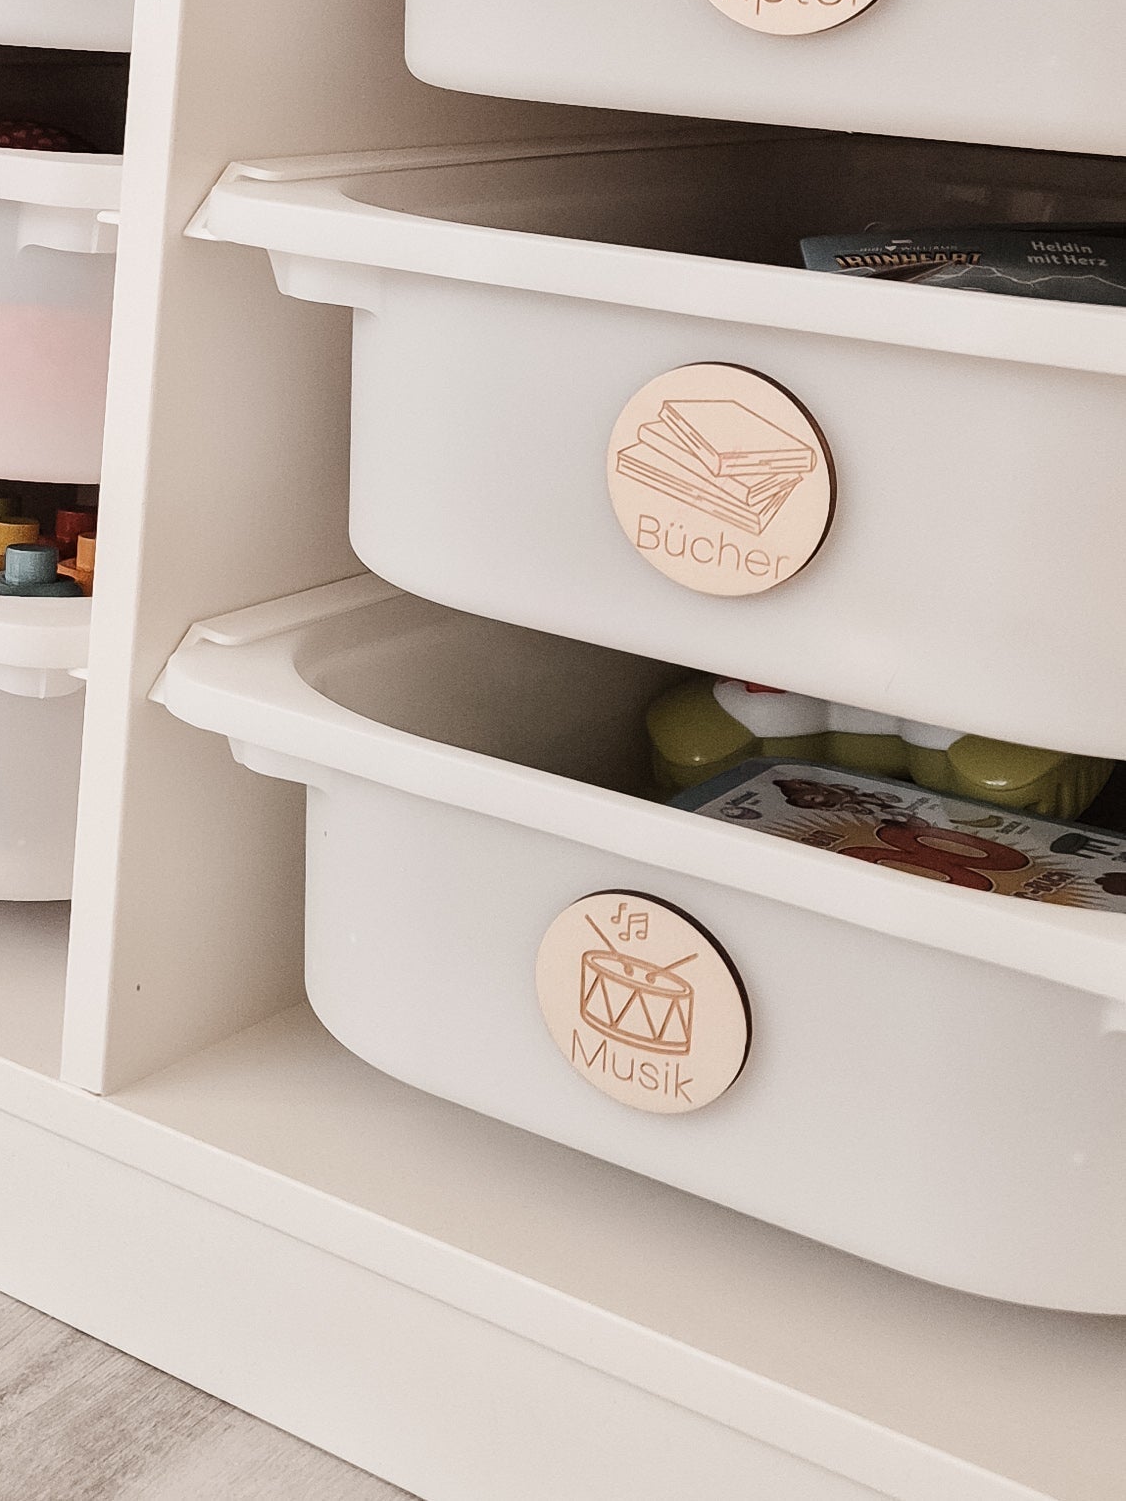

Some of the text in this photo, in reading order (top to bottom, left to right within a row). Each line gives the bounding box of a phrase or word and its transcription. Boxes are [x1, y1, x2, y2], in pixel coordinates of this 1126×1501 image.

[1027, 254, 1108, 267] mit Herz
[1031, 241, 1093, 254] Heldin
[636, 514, 790, 579] Bücher
[572, 1029, 693, 1103] Musik
